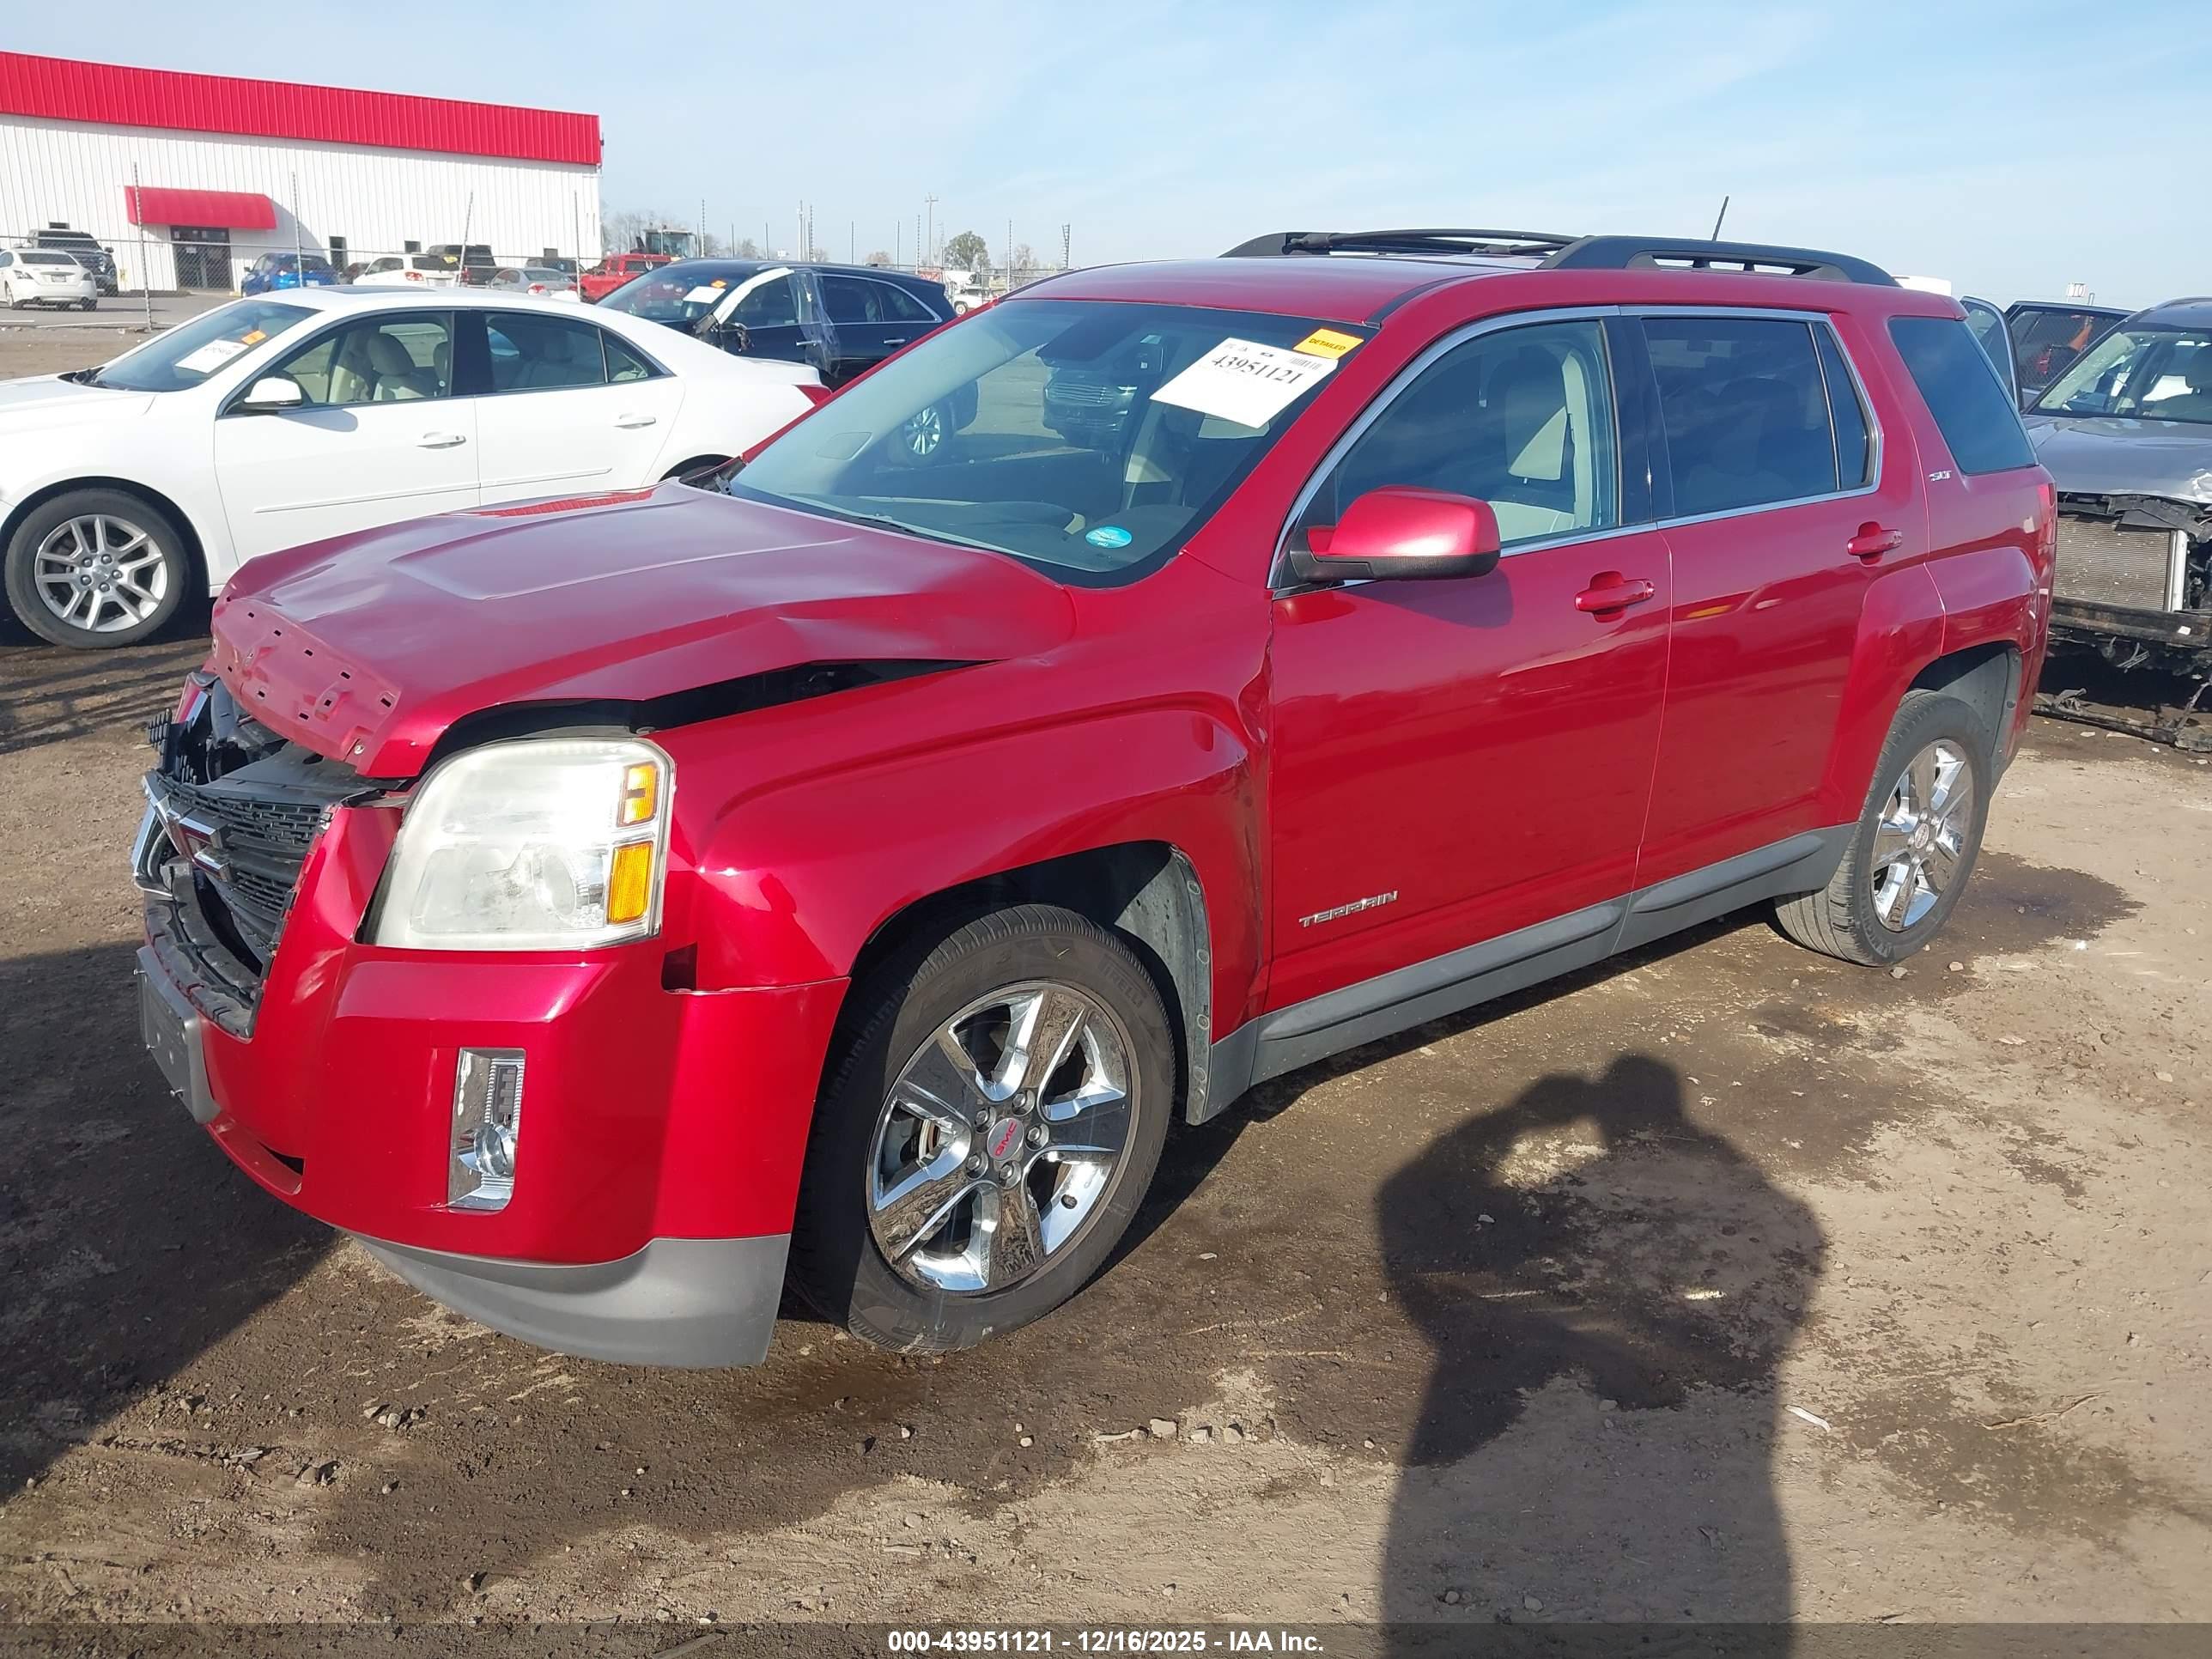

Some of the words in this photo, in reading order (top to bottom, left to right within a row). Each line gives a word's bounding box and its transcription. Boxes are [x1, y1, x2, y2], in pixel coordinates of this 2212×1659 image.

[1309, 337, 1346, 351] DETAILED
[1212, 355, 1303, 384] 43951121
[1298, 890, 1398, 927] TERRAIN
[994, 1121, 1018, 1157] GMC
